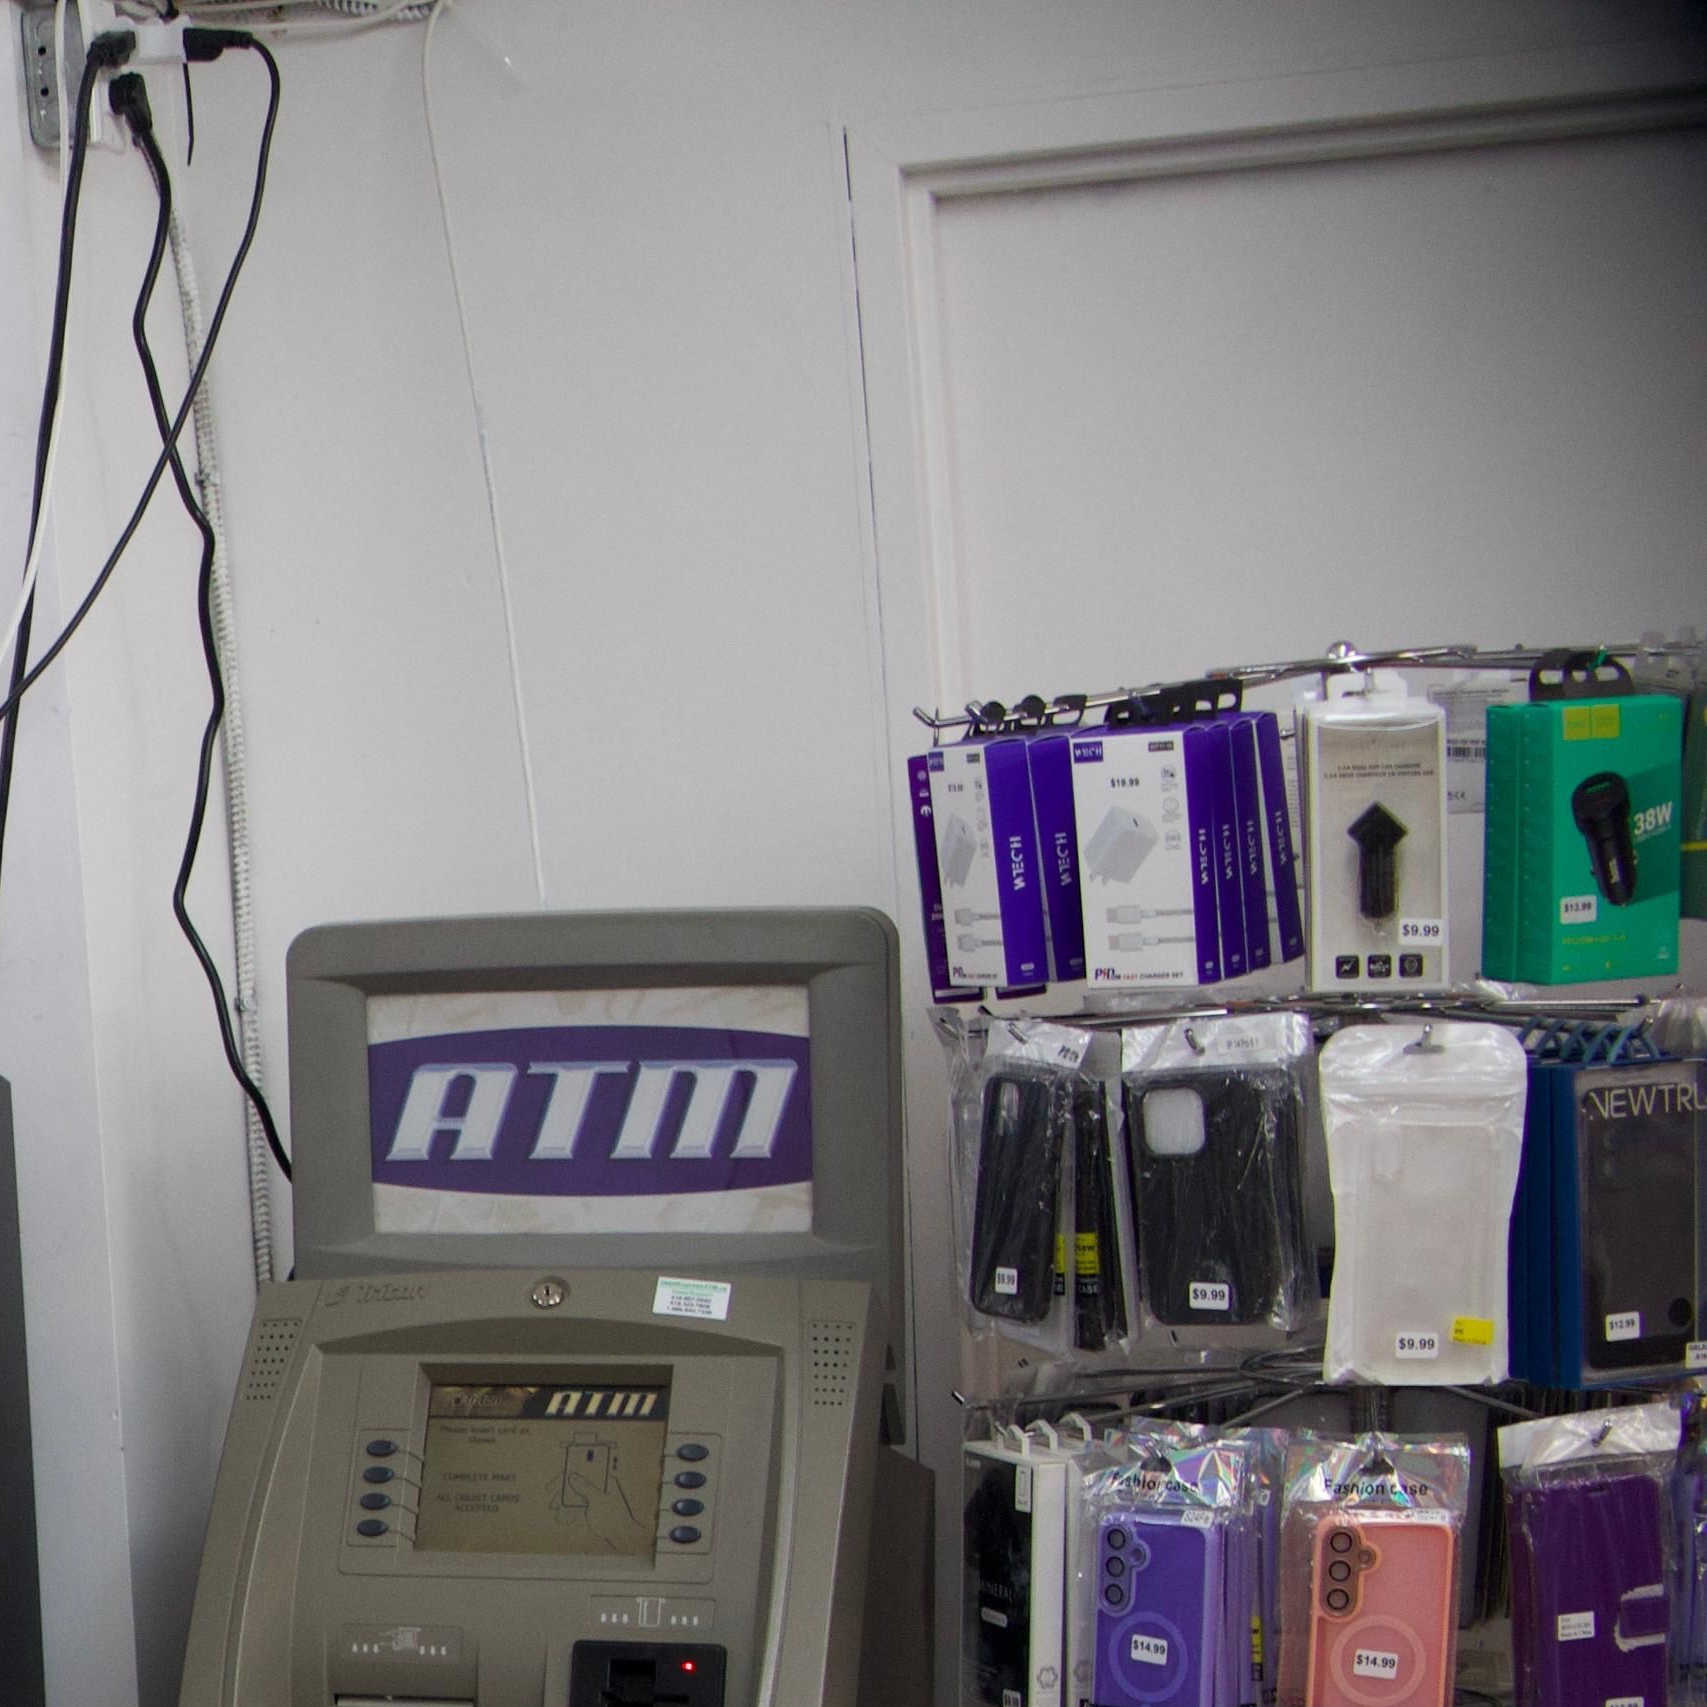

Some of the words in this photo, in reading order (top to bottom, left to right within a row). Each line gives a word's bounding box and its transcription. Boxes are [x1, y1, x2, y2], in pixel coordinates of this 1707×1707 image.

[1110, 777, 1140, 788] $19.99
[1633, 802, 1674, 836] 38W
[1009, 836, 1027, 891] WTECH
[1402, 922, 1441, 938] $9.99
[386, 1056, 800, 1162] ATM
[1192, 1288, 1226, 1301] $9.99
[1609, 1318, 1636, 1331] $12.99
[1398, 1337, 1435, 1351] $9.99
[545, 1390, 659, 1418] ATM
[1132, 1638, 1167, 1657] $14.99
[1355, 1653, 1396, 1670] $14.99
